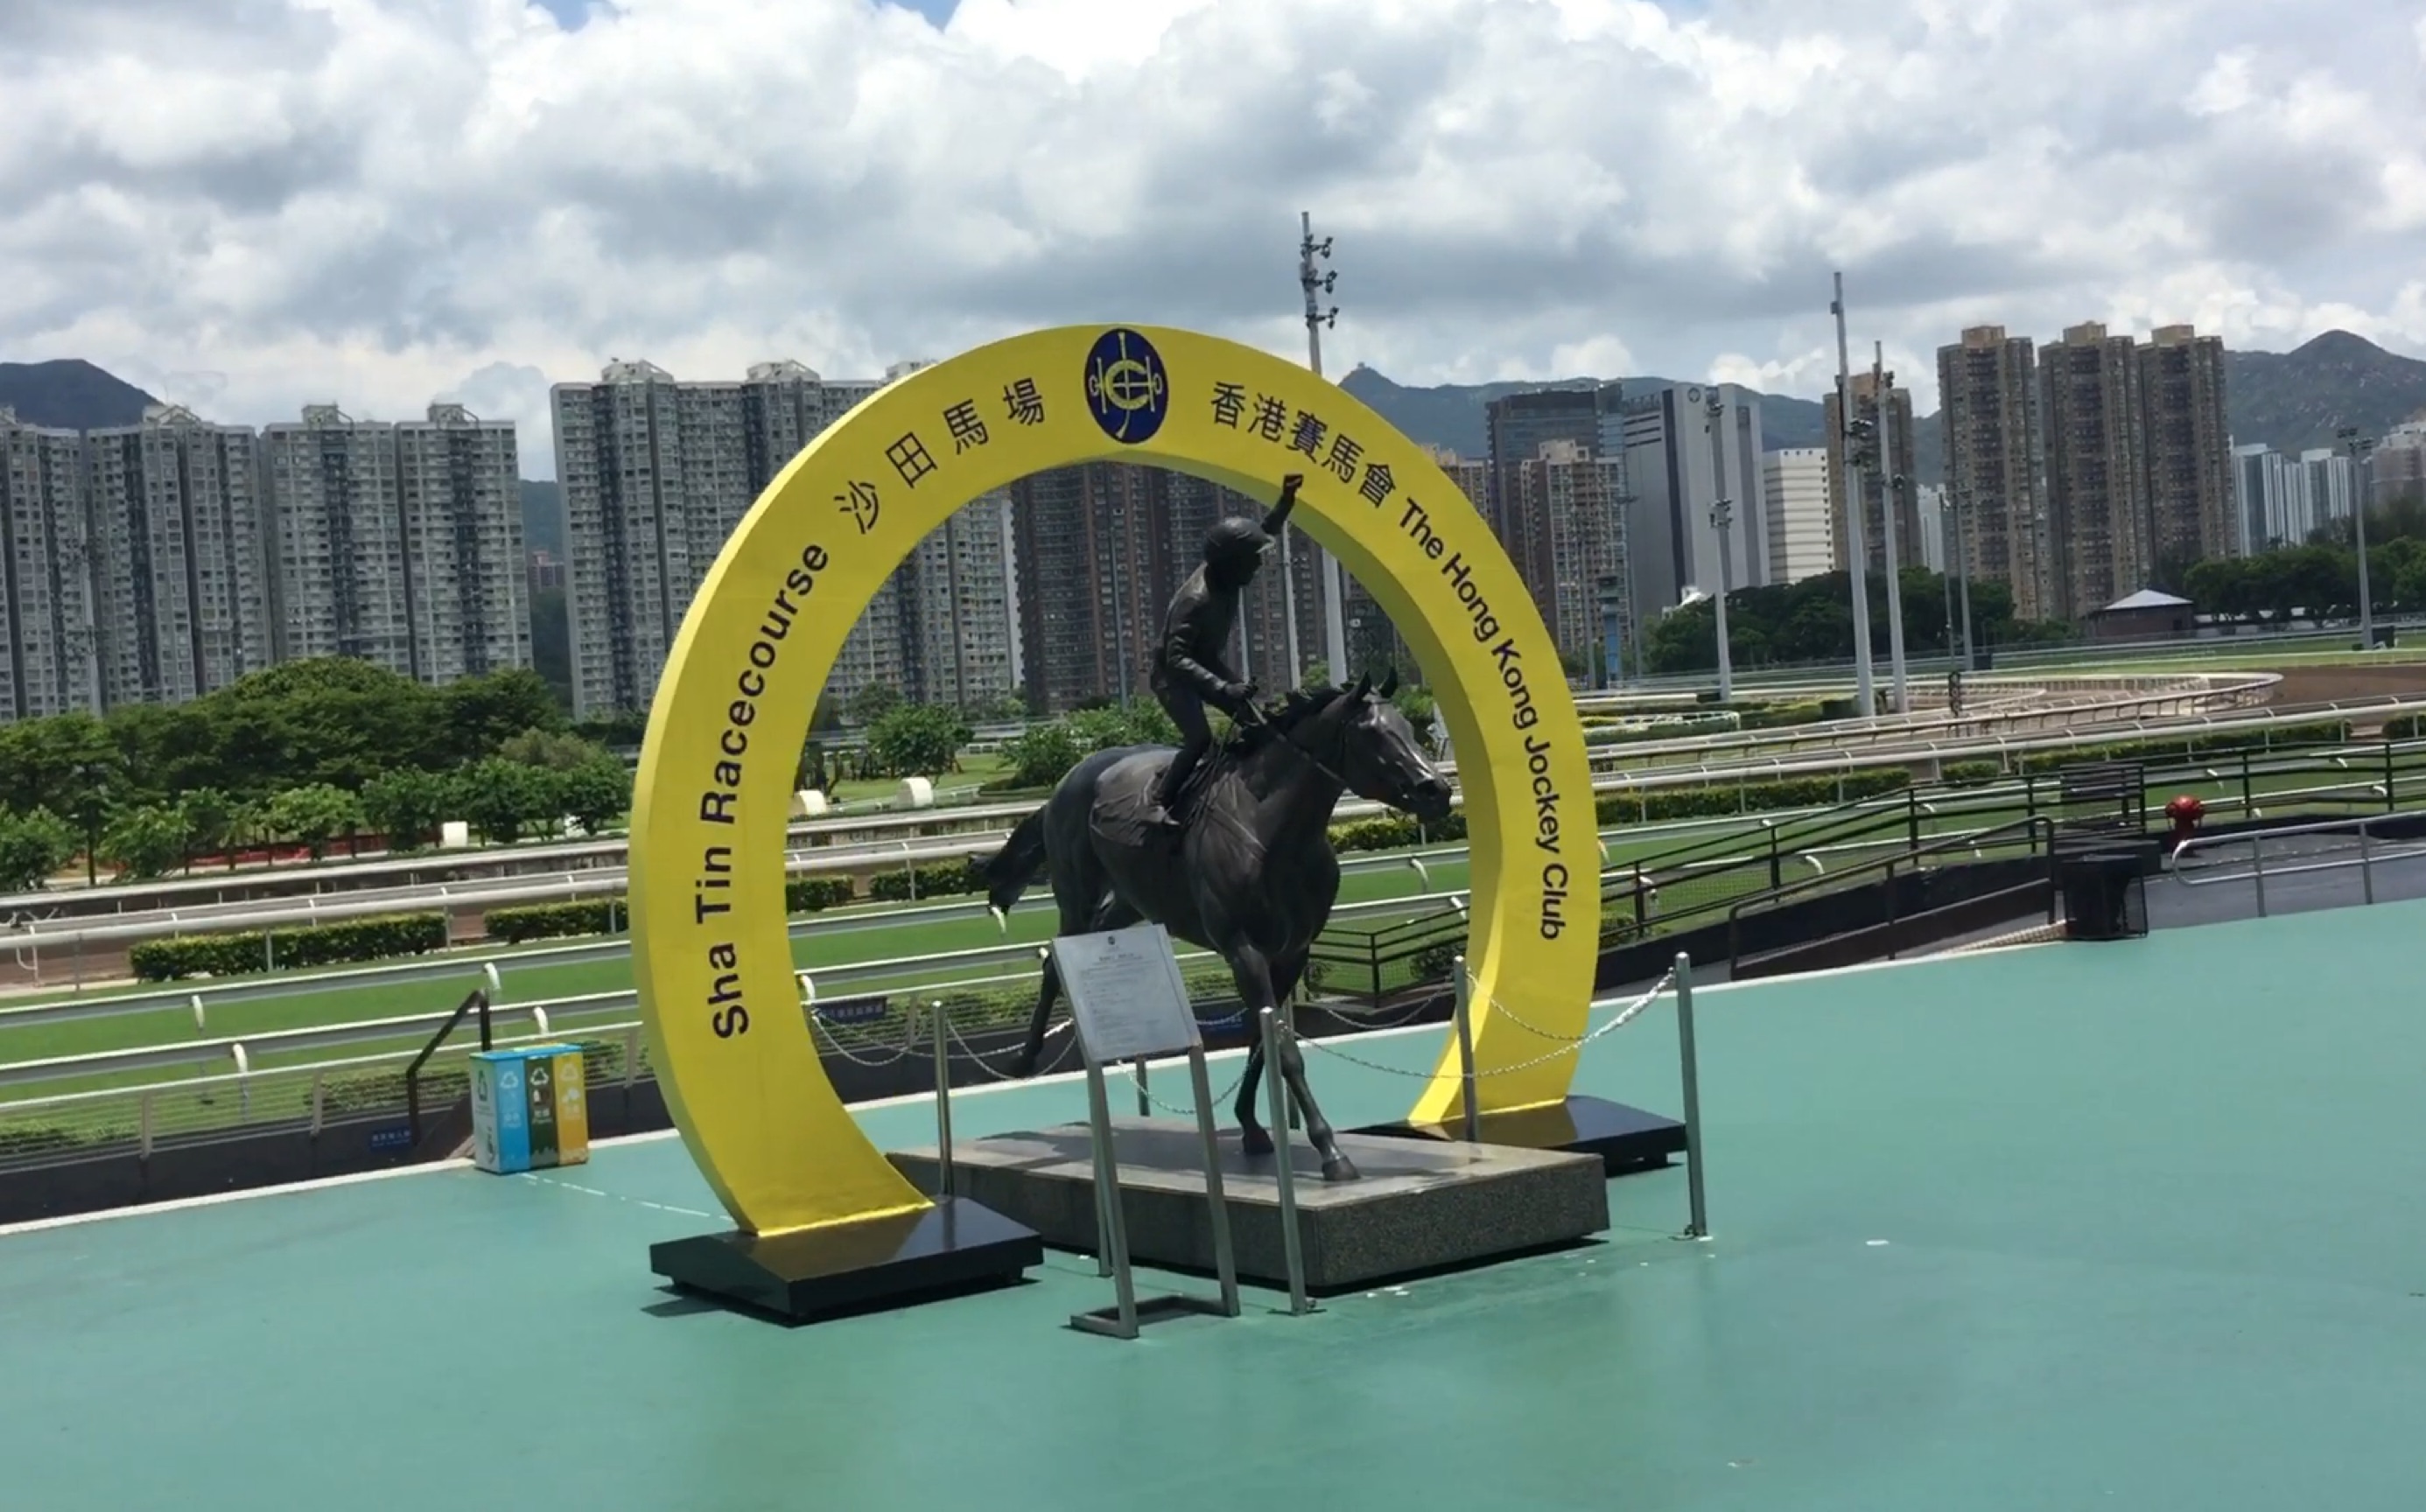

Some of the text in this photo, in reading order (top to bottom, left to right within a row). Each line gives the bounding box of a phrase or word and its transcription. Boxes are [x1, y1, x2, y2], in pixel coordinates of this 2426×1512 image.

[833, 377, 1045, 534] 沙田馬場
[1210, 382, 1397, 508] 香港賽馬會
[696, 544, 829, 1039] Sha Tin Racecourse
[1399, 497, 1568, 941] The Hong Kong Jockey Club
